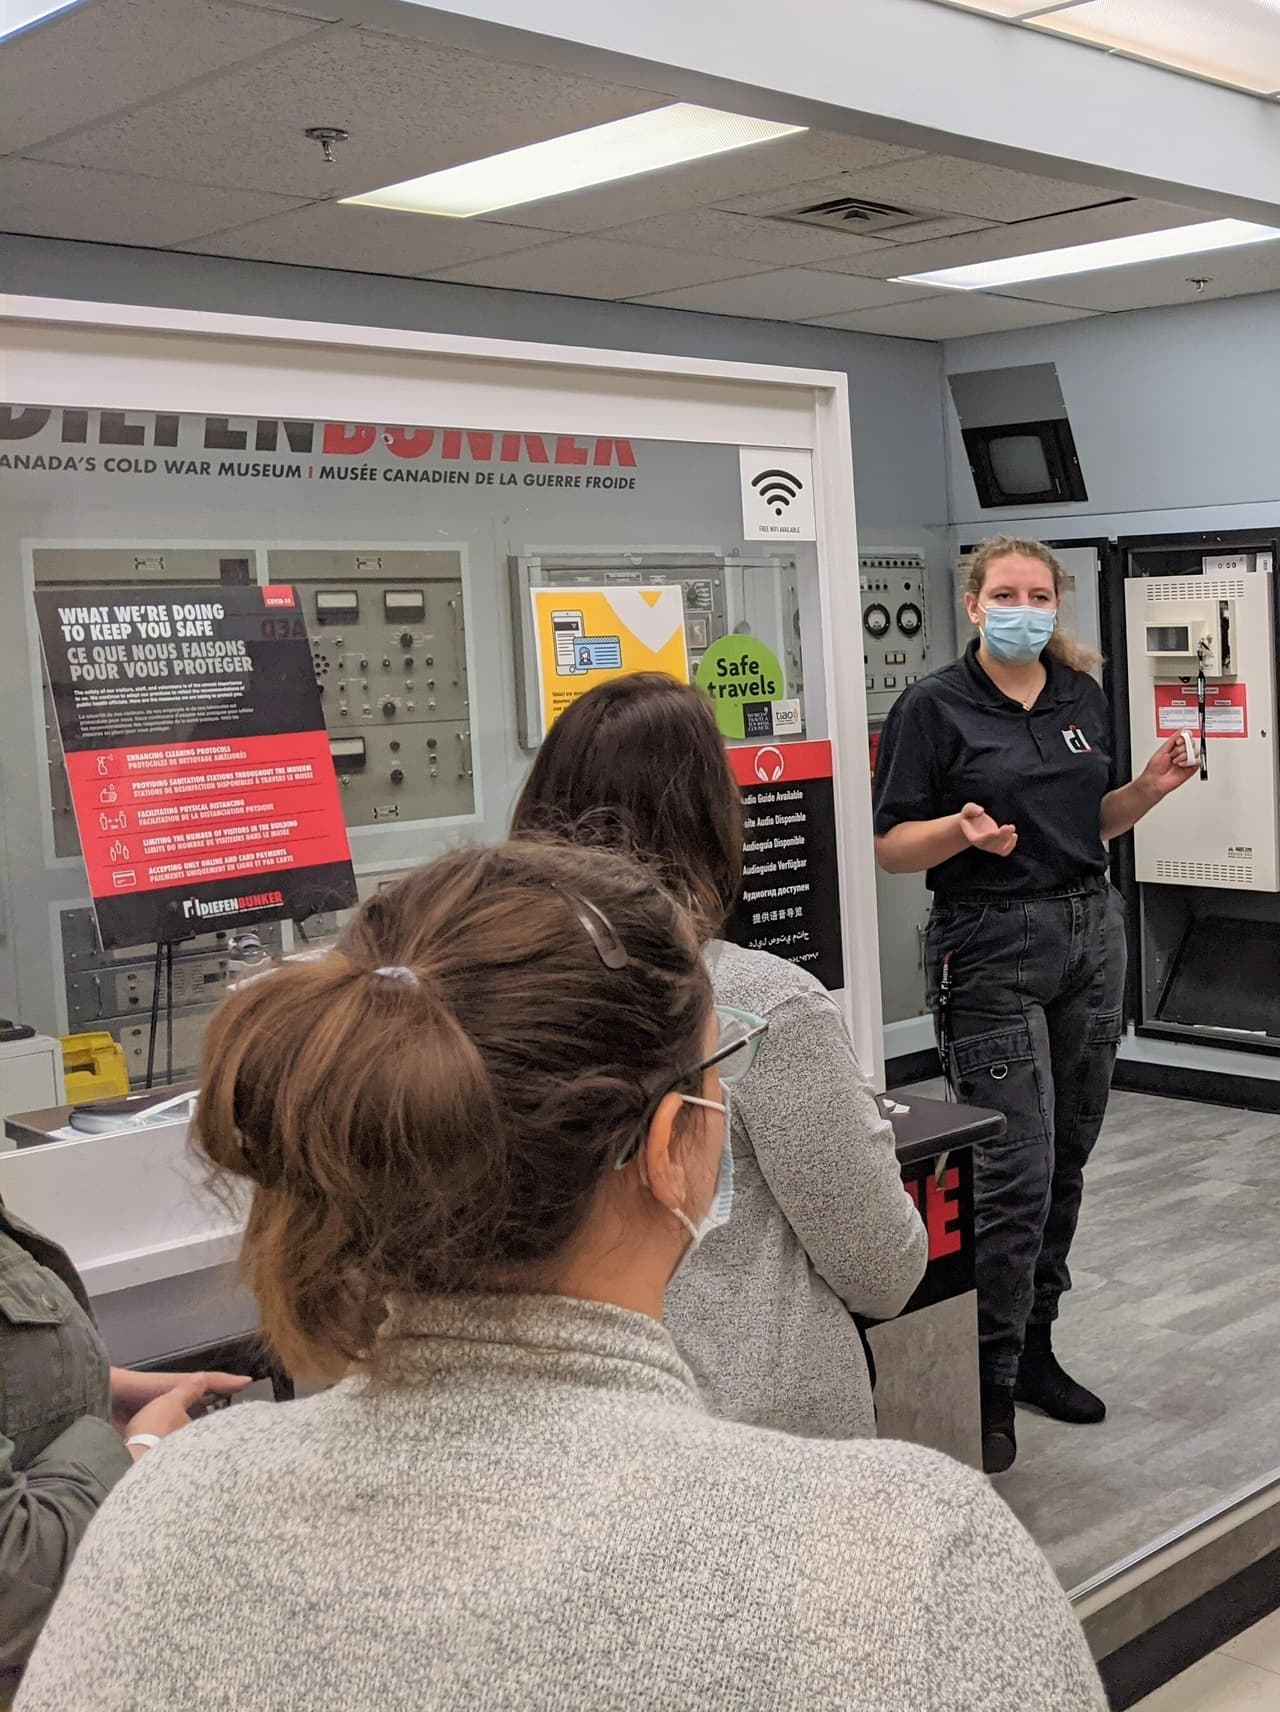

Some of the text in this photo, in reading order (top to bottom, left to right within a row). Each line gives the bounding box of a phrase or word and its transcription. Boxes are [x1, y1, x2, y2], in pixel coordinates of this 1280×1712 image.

[0, 454, 636, 490] ANADA'S COLD WAR MUSEUM MUSÉE CANADIEN DE LA GUERRE FROIDE
[58, 603, 225, 625] WHAT WE'RE DOING
[61, 620, 214, 642] TO KEEP YOU SAFE
[67, 640, 247, 664] CE QUE NOUS FAISONS
[69, 655, 254, 682] POUR VOUS PROTÉGER
[716, 654, 760, 678] Safe
[707, 674, 776, 699] travels
[757, 792, 776, 804] Guide
[776, 789, 804, 802] Available
[744, 812, 807, 829] site Audio Disponible
[773, 835, 805, 849] Disponible
[742, 858, 807, 877] Audioguide Verfügbar
[200, 890, 283, 916] DIEFENBUNKER
